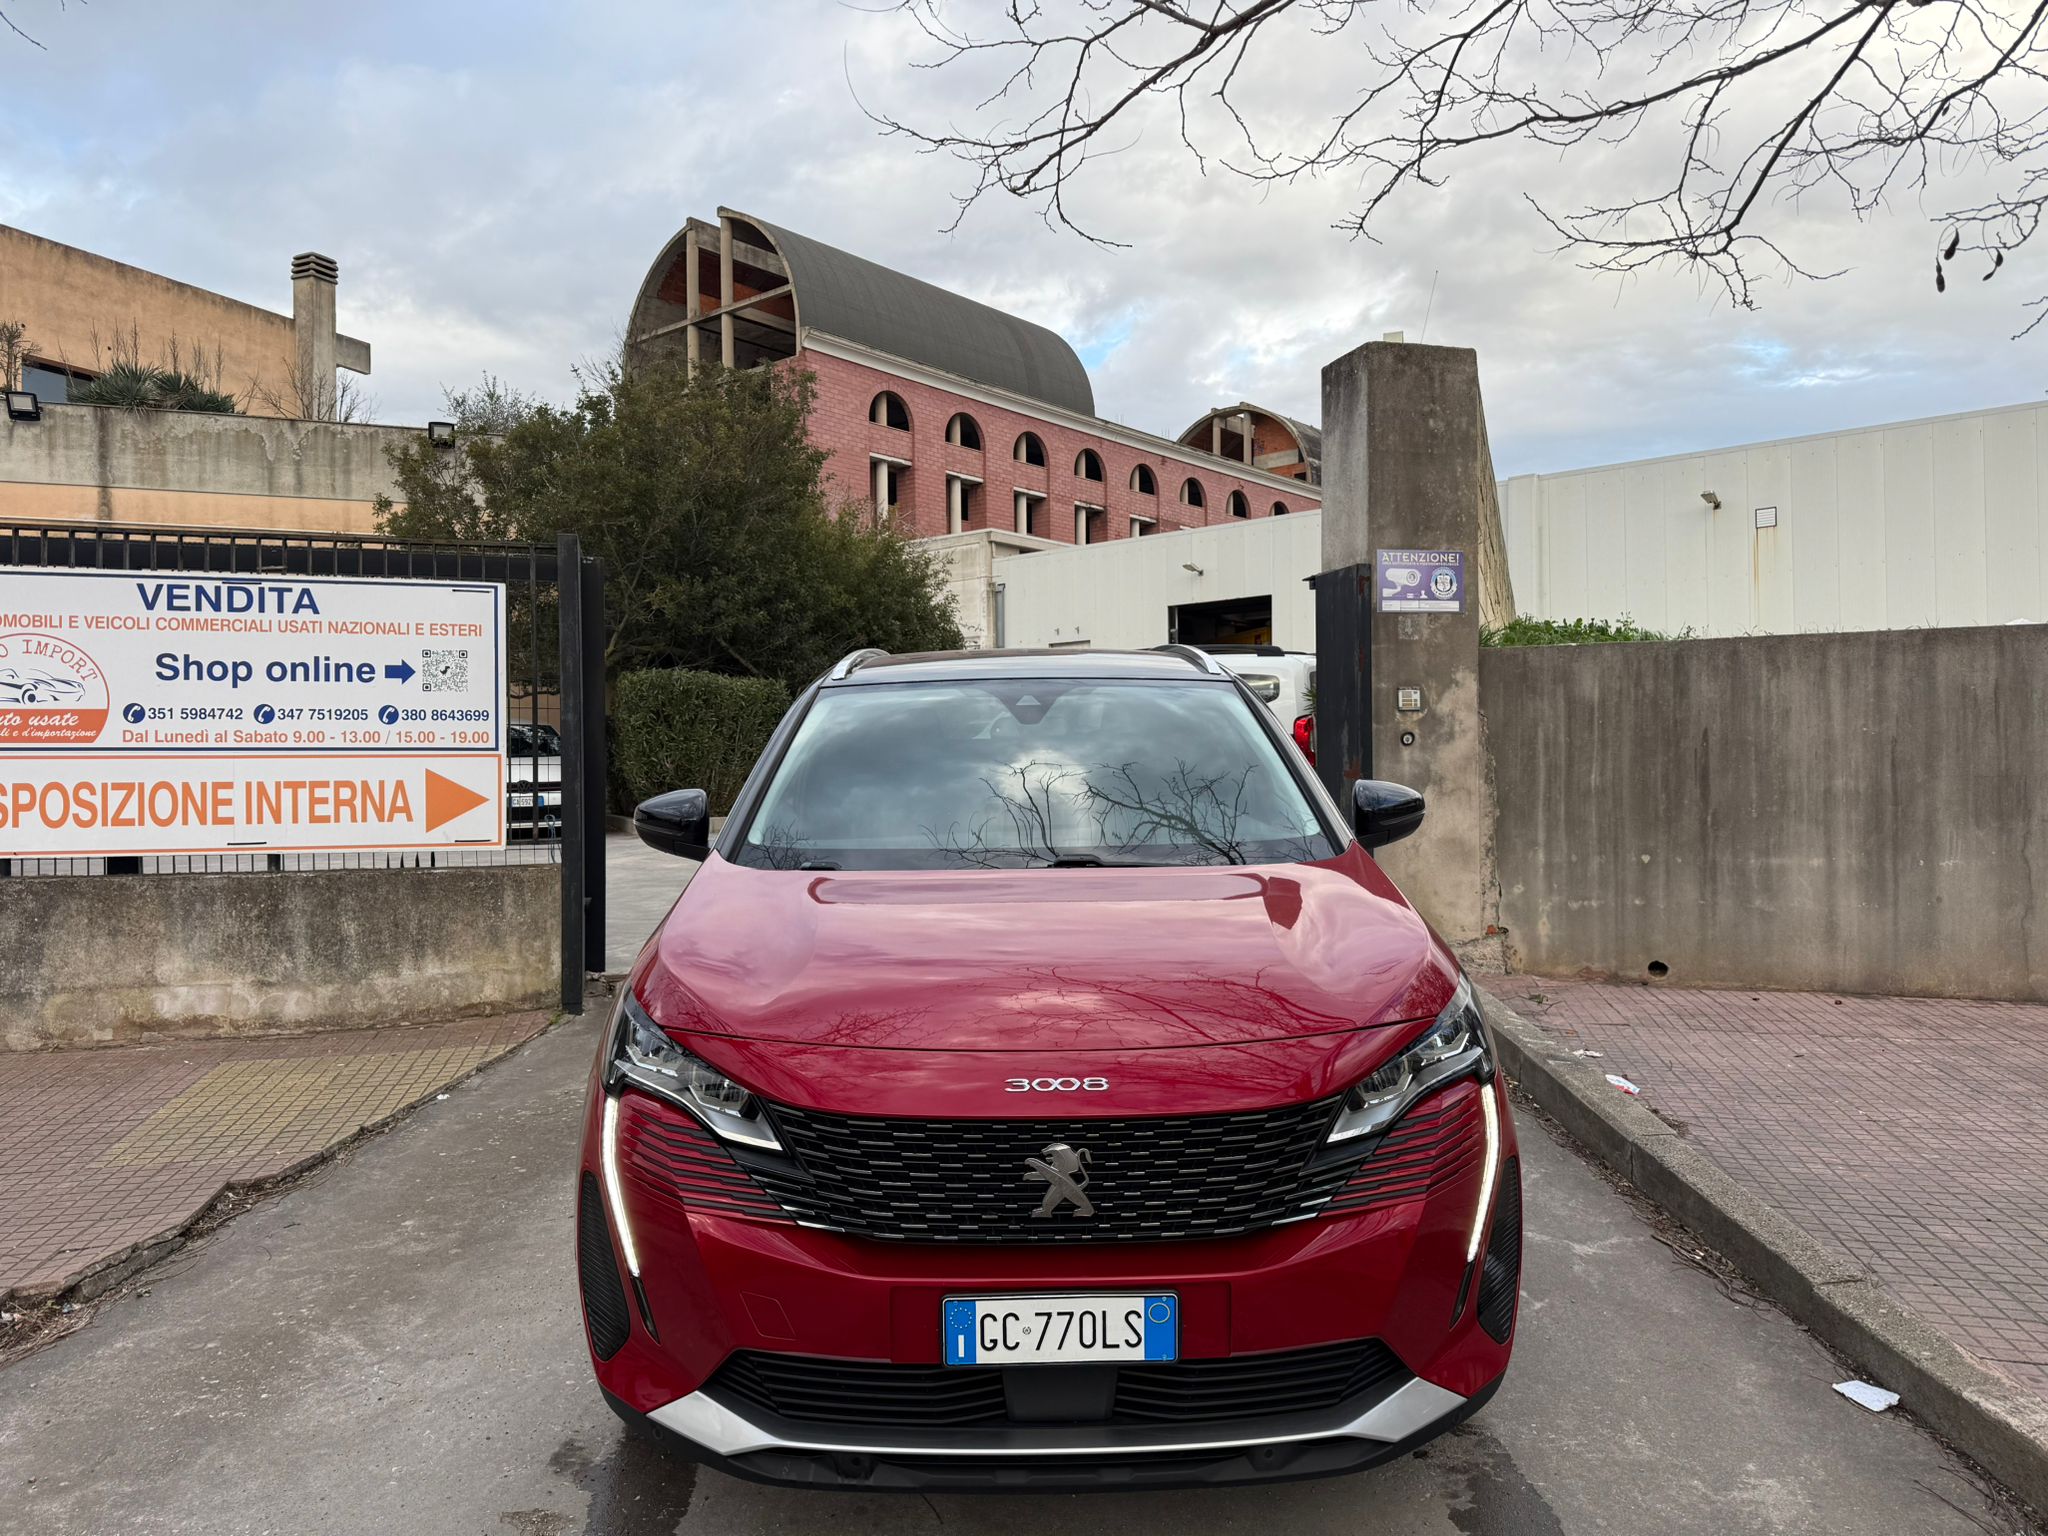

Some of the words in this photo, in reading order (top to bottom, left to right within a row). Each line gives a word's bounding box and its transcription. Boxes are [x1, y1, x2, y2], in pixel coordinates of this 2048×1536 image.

[1382, 552, 1460, 563] ATTENZIONE!
[136, 583, 320, 614] VENDITA
[0, 613, 63, 628] MOBILI
[69, 615, 79, 629] E
[84, 616, 150, 630] VEICOLI
[155, 617, 272, 633] COMMERCIALI
[278, 620, 323, 634] USATI
[328, 621, 410, 636] NAZIONALI
[415, 622, 425, 636] E
[430, 623, 482, 637] ESTERI
[22, 639, 98, 682] IMPORT
[155, 652, 253, 688] Shop
[266, 655, 376, 683] online
[29, 711, 79, 726] usate
[148, 707, 174, 720] 351
[180, 707, 243, 720] 5984742
[277, 708, 304, 721] 347
[309, 708, 369, 721] 7519205
[401, 709, 427, 721] 380
[431, 709, 490, 722] 8643699
[122, 729, 149, 743] Dal
[155, 729, 209, 743] Lunedì
[215, 730, 228, 743] al
[233, 730, 288, 744] Sabato
[293, 730, 326, 743] 9.00
[340, 730, 381, 744] 13.00
[396, 730, 435, 744] 15.00
[450, 731, 490, 744] 19.00
[245, 780, 414, 825] INTERNA
[1004, 1077, 1110, 1092] 3008
